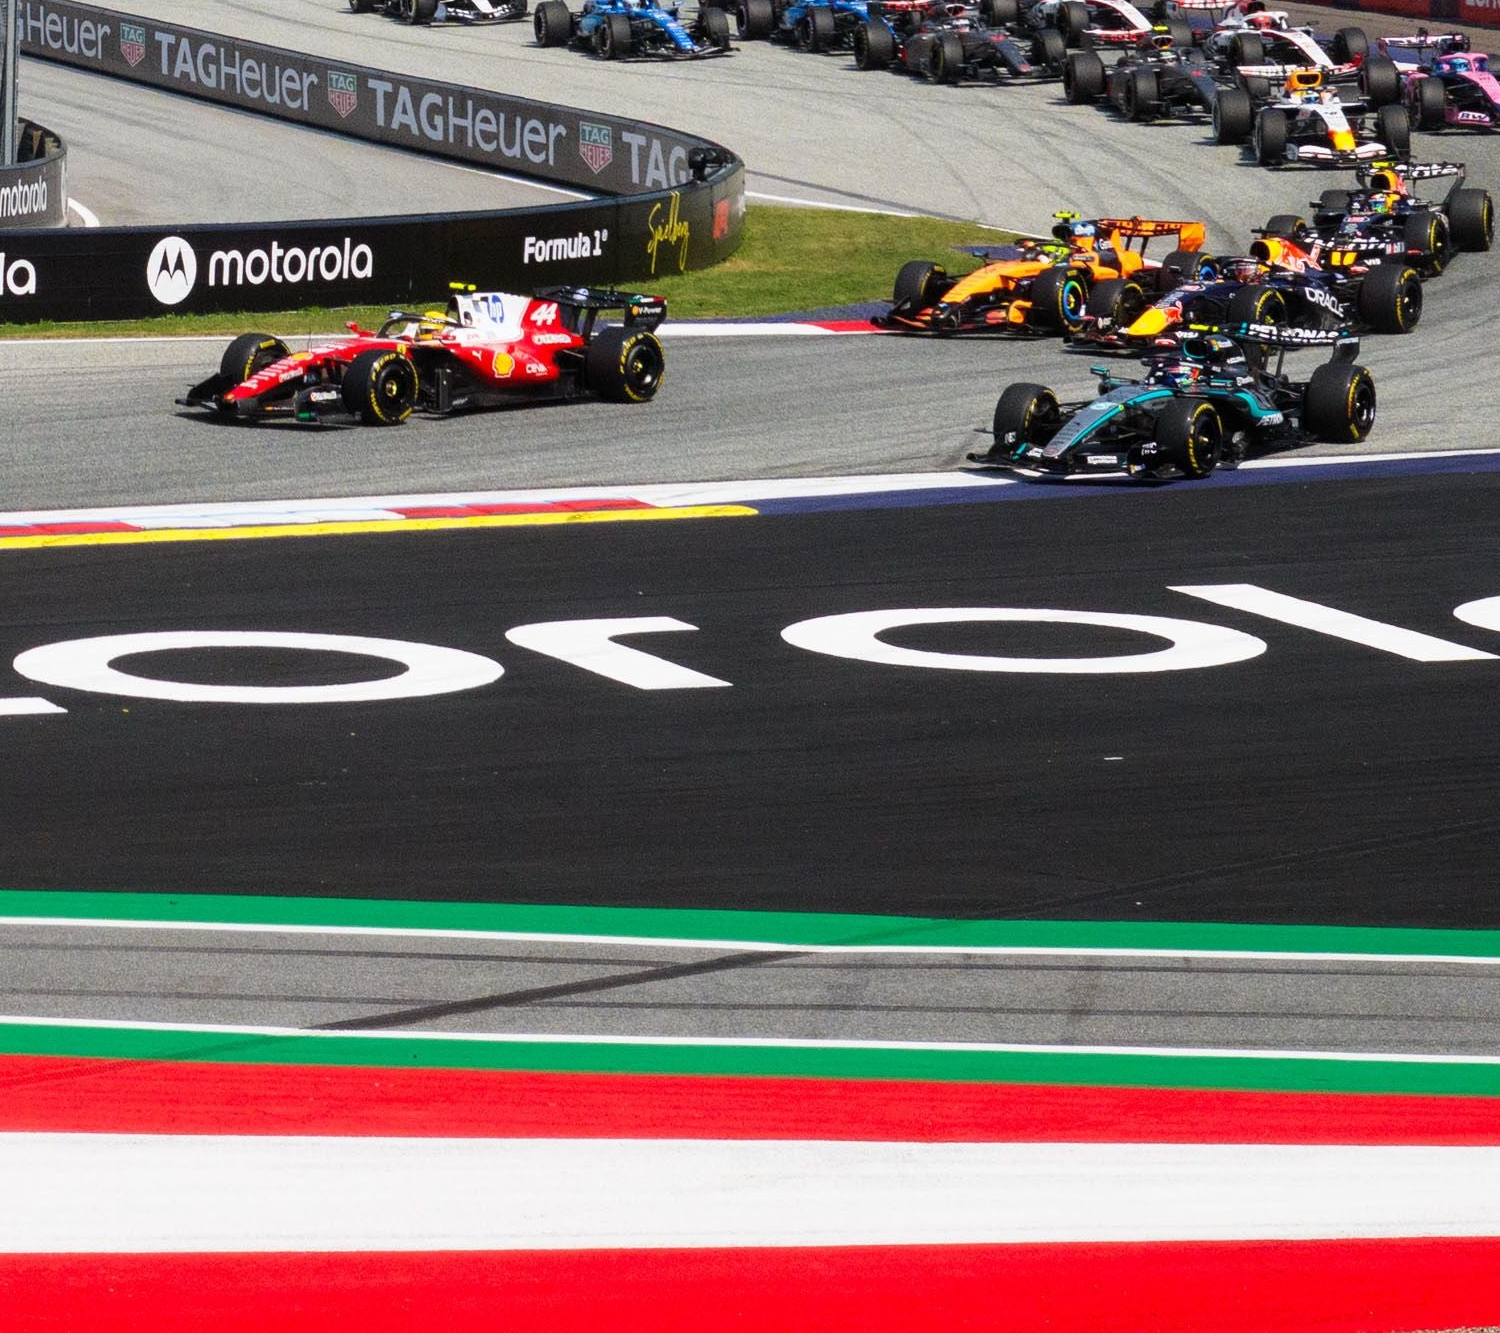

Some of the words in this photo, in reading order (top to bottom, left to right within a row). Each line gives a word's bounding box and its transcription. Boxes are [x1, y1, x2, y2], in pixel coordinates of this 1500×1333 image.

[122, 25, 145, 44] TAG
[120, 42, 146, 62] HEUER
[329, 73, 355, 91] TAG
[328, 90, 357, 113] HEUER
[582, 123, 611, 143] TAG
[580, 143, 612, 170] HEUER
[523, 232, 591, 264] Formula
[208, 237, 373, 286] motorola
[530, 302, 558, 325] 44
[1305, 287, 1344, 317] ORACLE
